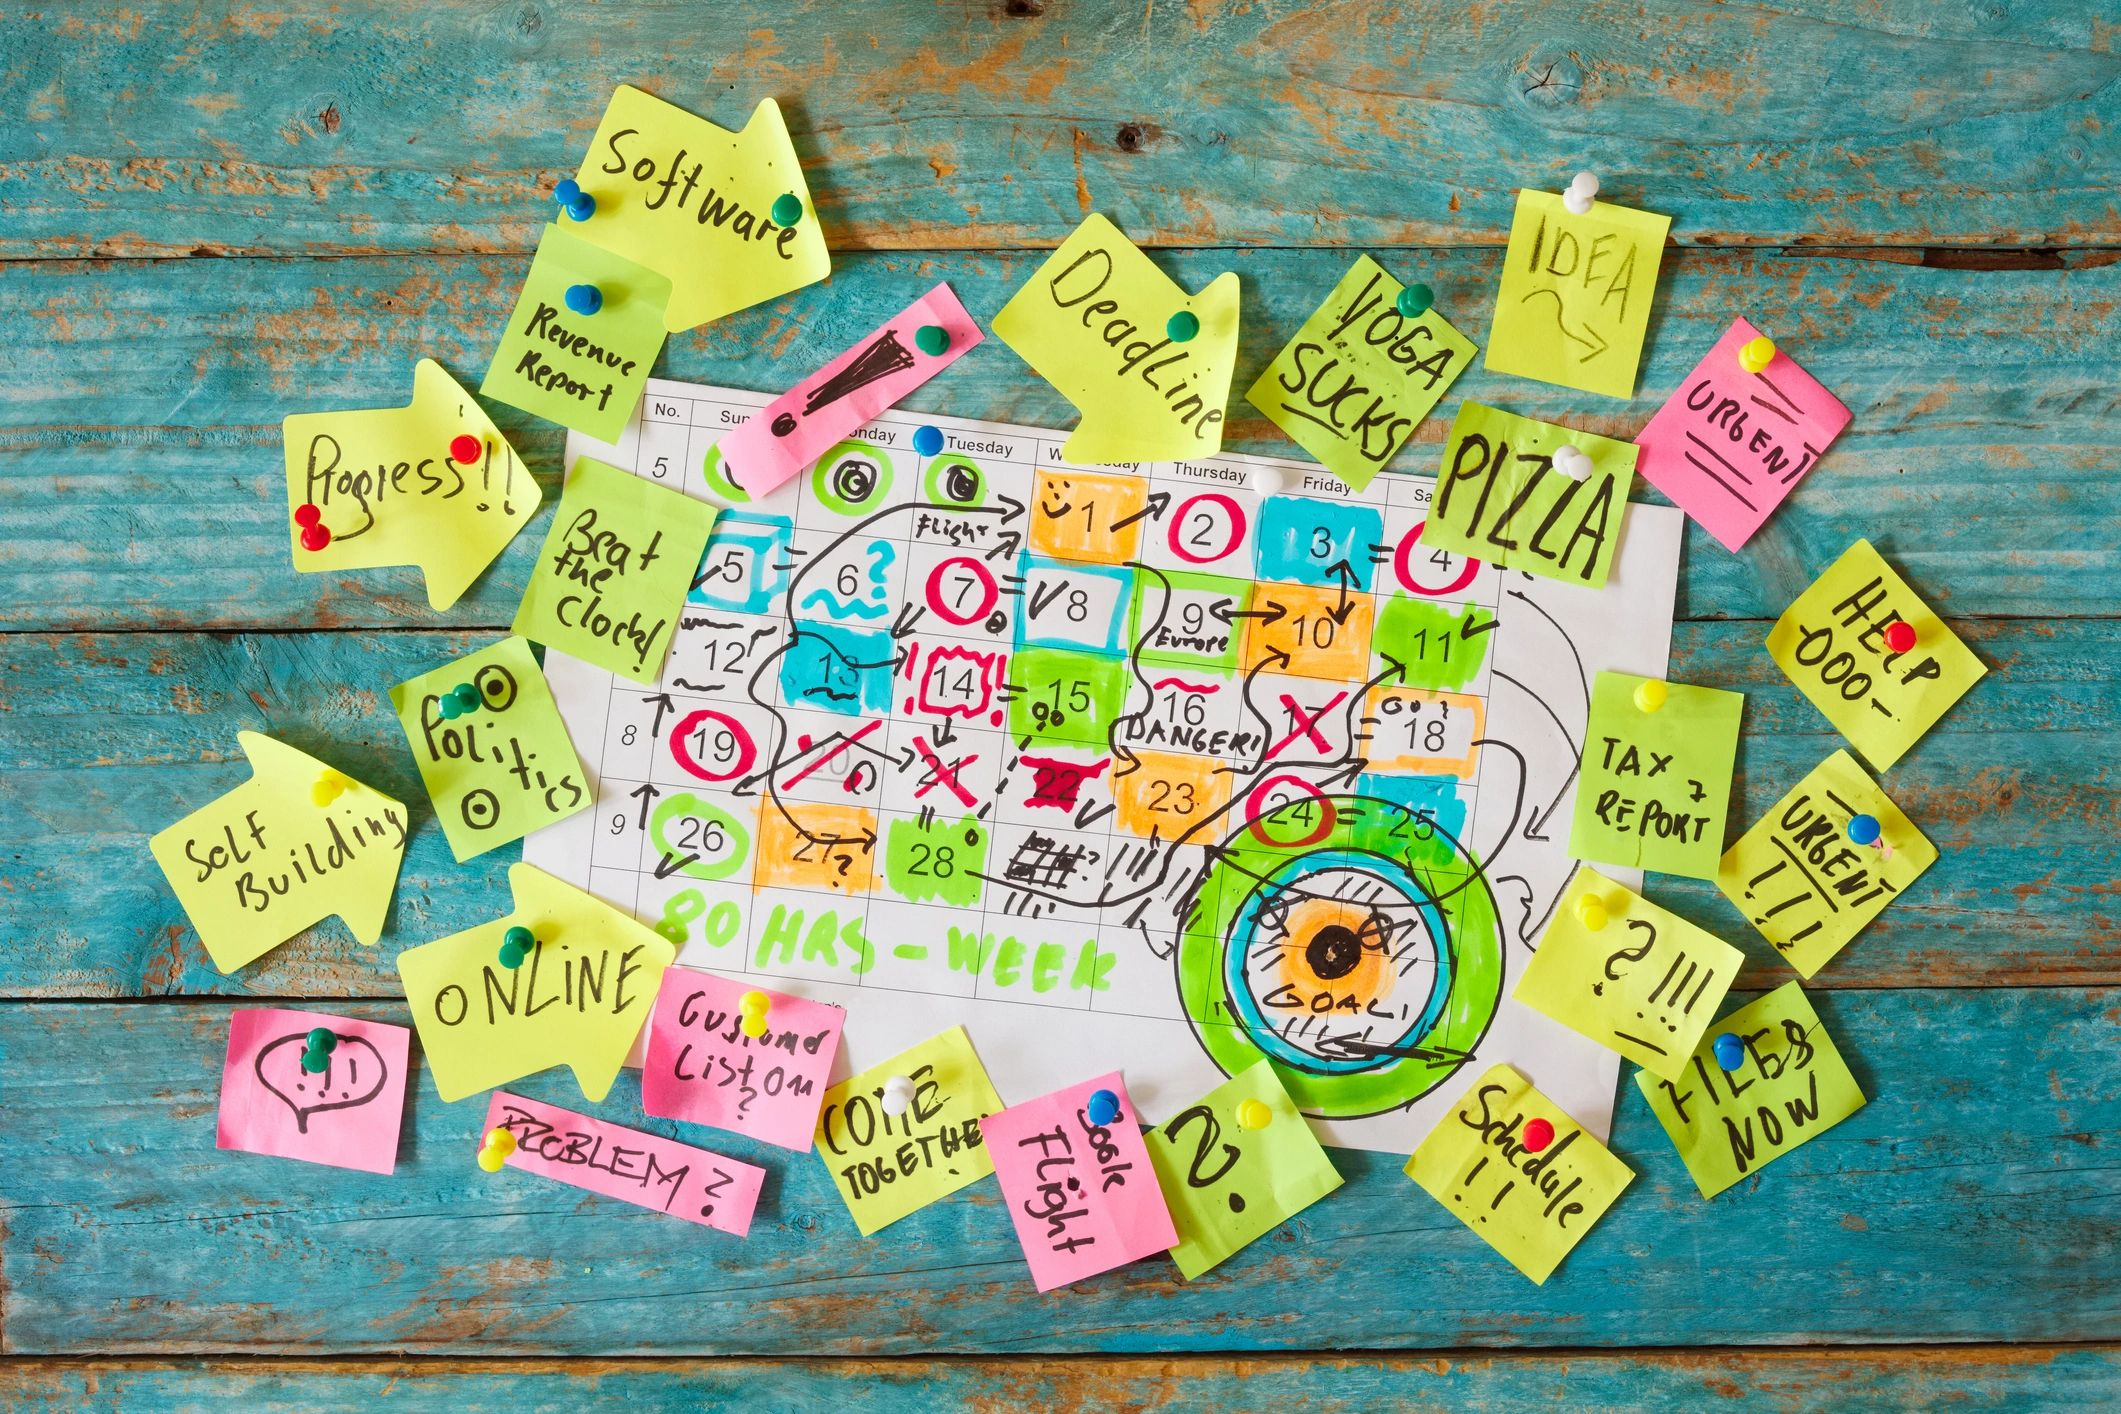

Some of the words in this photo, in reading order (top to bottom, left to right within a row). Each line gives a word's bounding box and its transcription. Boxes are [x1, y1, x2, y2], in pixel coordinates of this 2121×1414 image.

[602, 129, 798, 259] Software
[1528, 214, 1638, 324] IDEA
[515, 349, 614, 411] Report
[524, 302, 637, 376] Revenue
[1327, 272, 1455, 390] YOGA
[655, 402, 680, 418] No.
[849, 427, 896, 445] onday
[947, 435, 1014, 457] Tuesday
[1173, 461, 1247, 485] Thursday
[1303, 476, 1352, 496] Friday
[1279, 341, 1411, 462] SUCKS
[563, 508, 663, 573] Beat
[652, 457, 669, 479] 5
[1081, 501, 1094, 532] 1
[1190, 514, 1215, 547] 2
[1310, 526, 1332, 559] 3
[1430, 548, 1452, 572] 4
[1437, 433, 1615, 580] PIZZA
[554, 550, 614, 594] the
[721, 551, 745, 583] 5
[837, 565, 859, 597] 6
[953, 576, 976, 609] 7
[1066, 590, 1089, 622] 8
[1182, 603, 1204, 635] 9
[1292, 617, 1334, 650] 10
[1413, 631, 1452, 663] 11
[1155, 626, 1229, 653] Europe
[704, 639, 746, 673] 12
[818, 652, 860, 687] 13
[933, 665, 975, 700] 14
[1048, 678, 1091, 712] 15
[1163, 691, 1206, 726] 16
[1282, 704, 1326, 739] 17
[1404, 717, 1446, 753] 18
[621, 724, 638, 746] 8
[693, 728, 736, 763] 19
[803, 739, 851, 776] 20
[917, 753, 961, 788] 21
[1033, 766, 1081, 802] 22
[1147, 779, 1195, 815] 23
[1266, 791, 1315, 828] 24
[1388, 807, 1436, 842] 25
[1603, 736, 1674, 777] TAX
[235, 800, 407, 912] Building
[610, 812, 626, 836] 9
[678, 816, 725, 852] 26
[792, 830, 841, 864] 27
[907, 843, 955, 879] 28
[1595, 789, 1711, 844] REPORT
[1781, 795, 1897, 908] URGENT
[655, 888, 741, 948] 80
[754, 903, 875, 974] HRS
[947, 926, 1118, 993] WEEK
[674, 1044, 755, 1088] List
[497, 1106, 690, 1211] PROBLEM
[841, 1112, 989, 1199] TOGETHE
[1722, 1070, 1819, 1173] NOW
